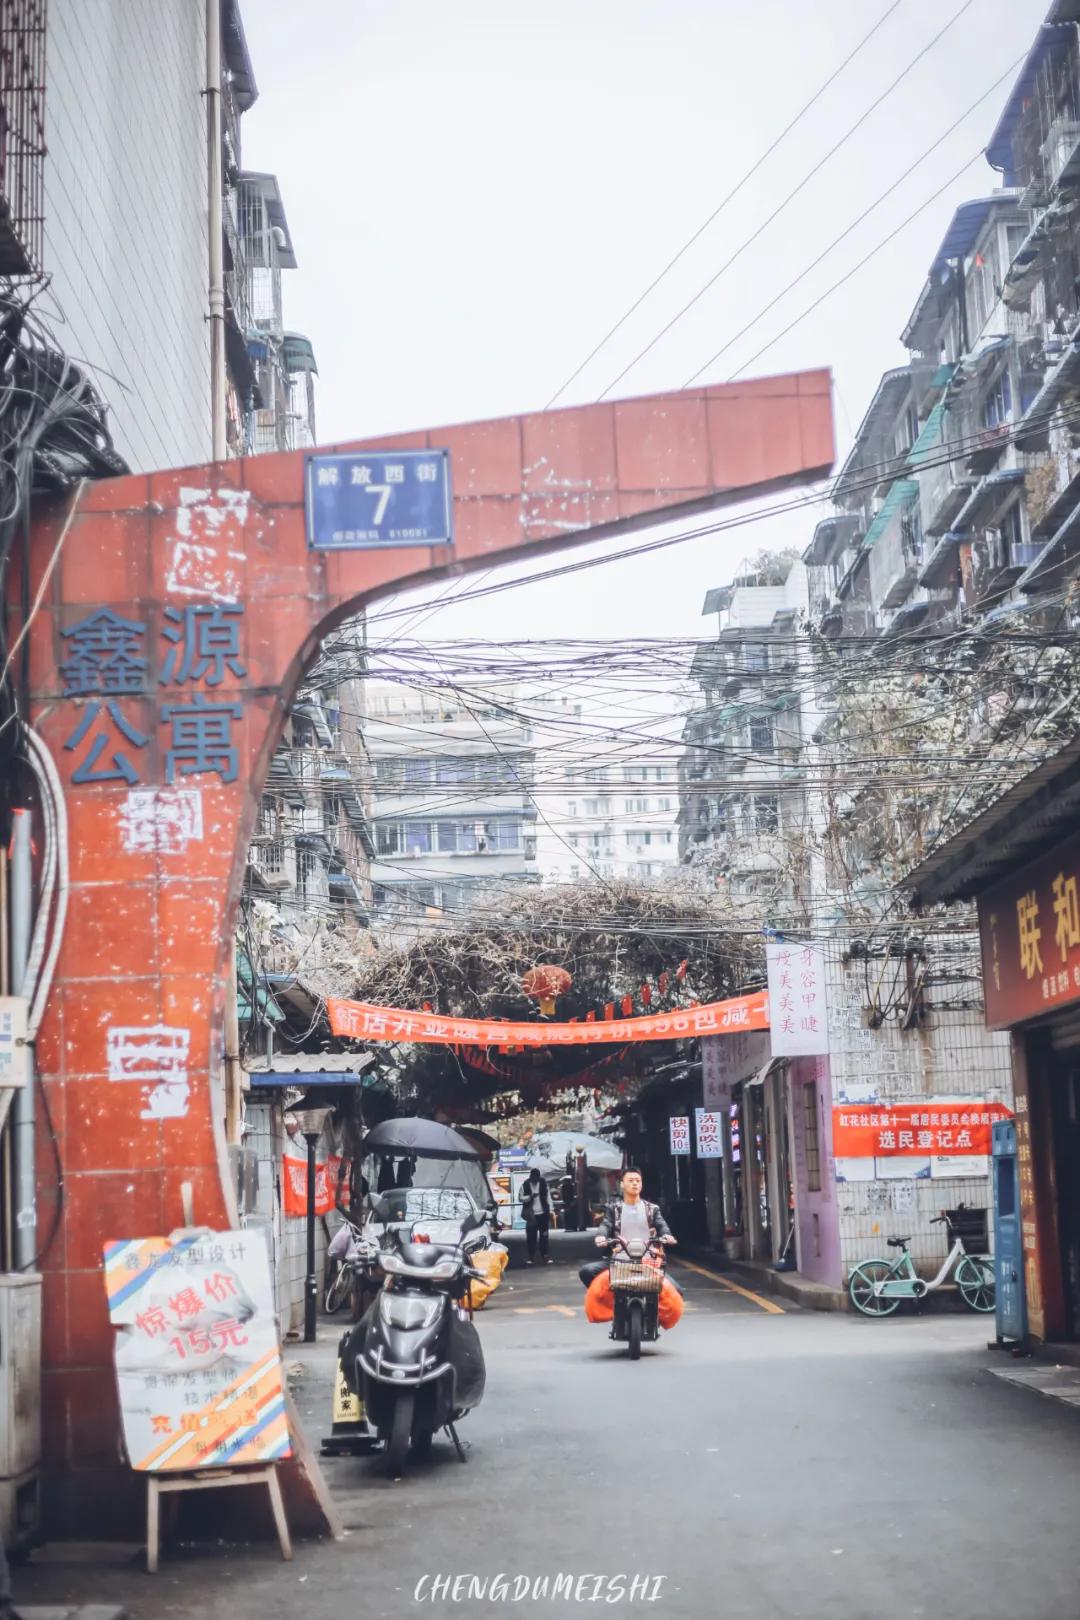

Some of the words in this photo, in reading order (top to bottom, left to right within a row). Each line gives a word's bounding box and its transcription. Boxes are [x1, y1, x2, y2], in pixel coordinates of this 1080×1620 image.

[318, 463, 437, 486] 解放西街
[365, 485, 391, 525] 7
[60, 604, 248, 697] 鑫源
[63, 694, 244, 786] 公寓
[671, 1118, 687, 1139] 快剪
[699, 1114, 719, 1143] 洗剪吹
[878, 1130, 972, 1149] 选民登记点
[135, 1272, 240, 1338] 惊爆价
[169, 1319, 250, 1359] 15元
